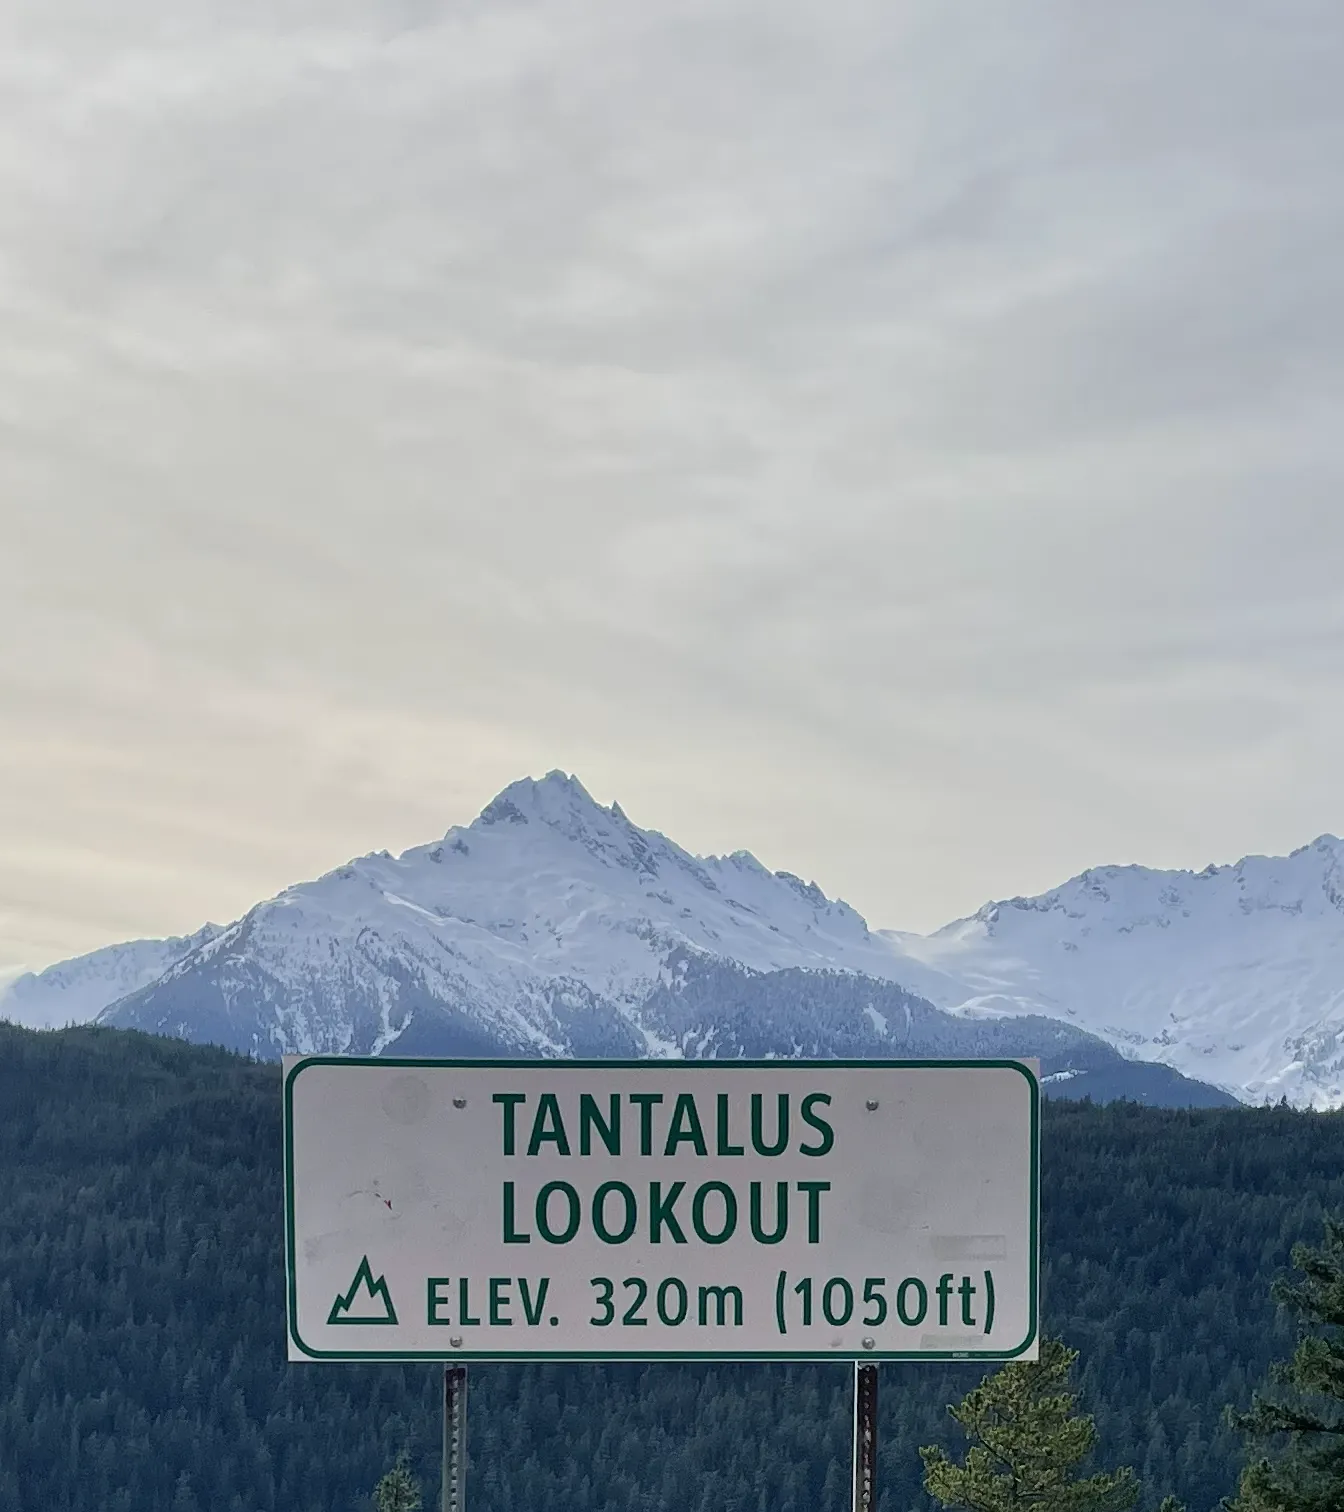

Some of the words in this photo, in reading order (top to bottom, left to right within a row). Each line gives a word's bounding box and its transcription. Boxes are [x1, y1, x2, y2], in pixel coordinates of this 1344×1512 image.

[491, 1092, 835, 1157] TANTALUS
[503, 1180, 831, 1245] LOOKOUT
[427, 1277, 559, 1327] ELEV.
[589, 1277, 744, 1327] 320m
[775, 1269, 995, 1335] (1050ft)
